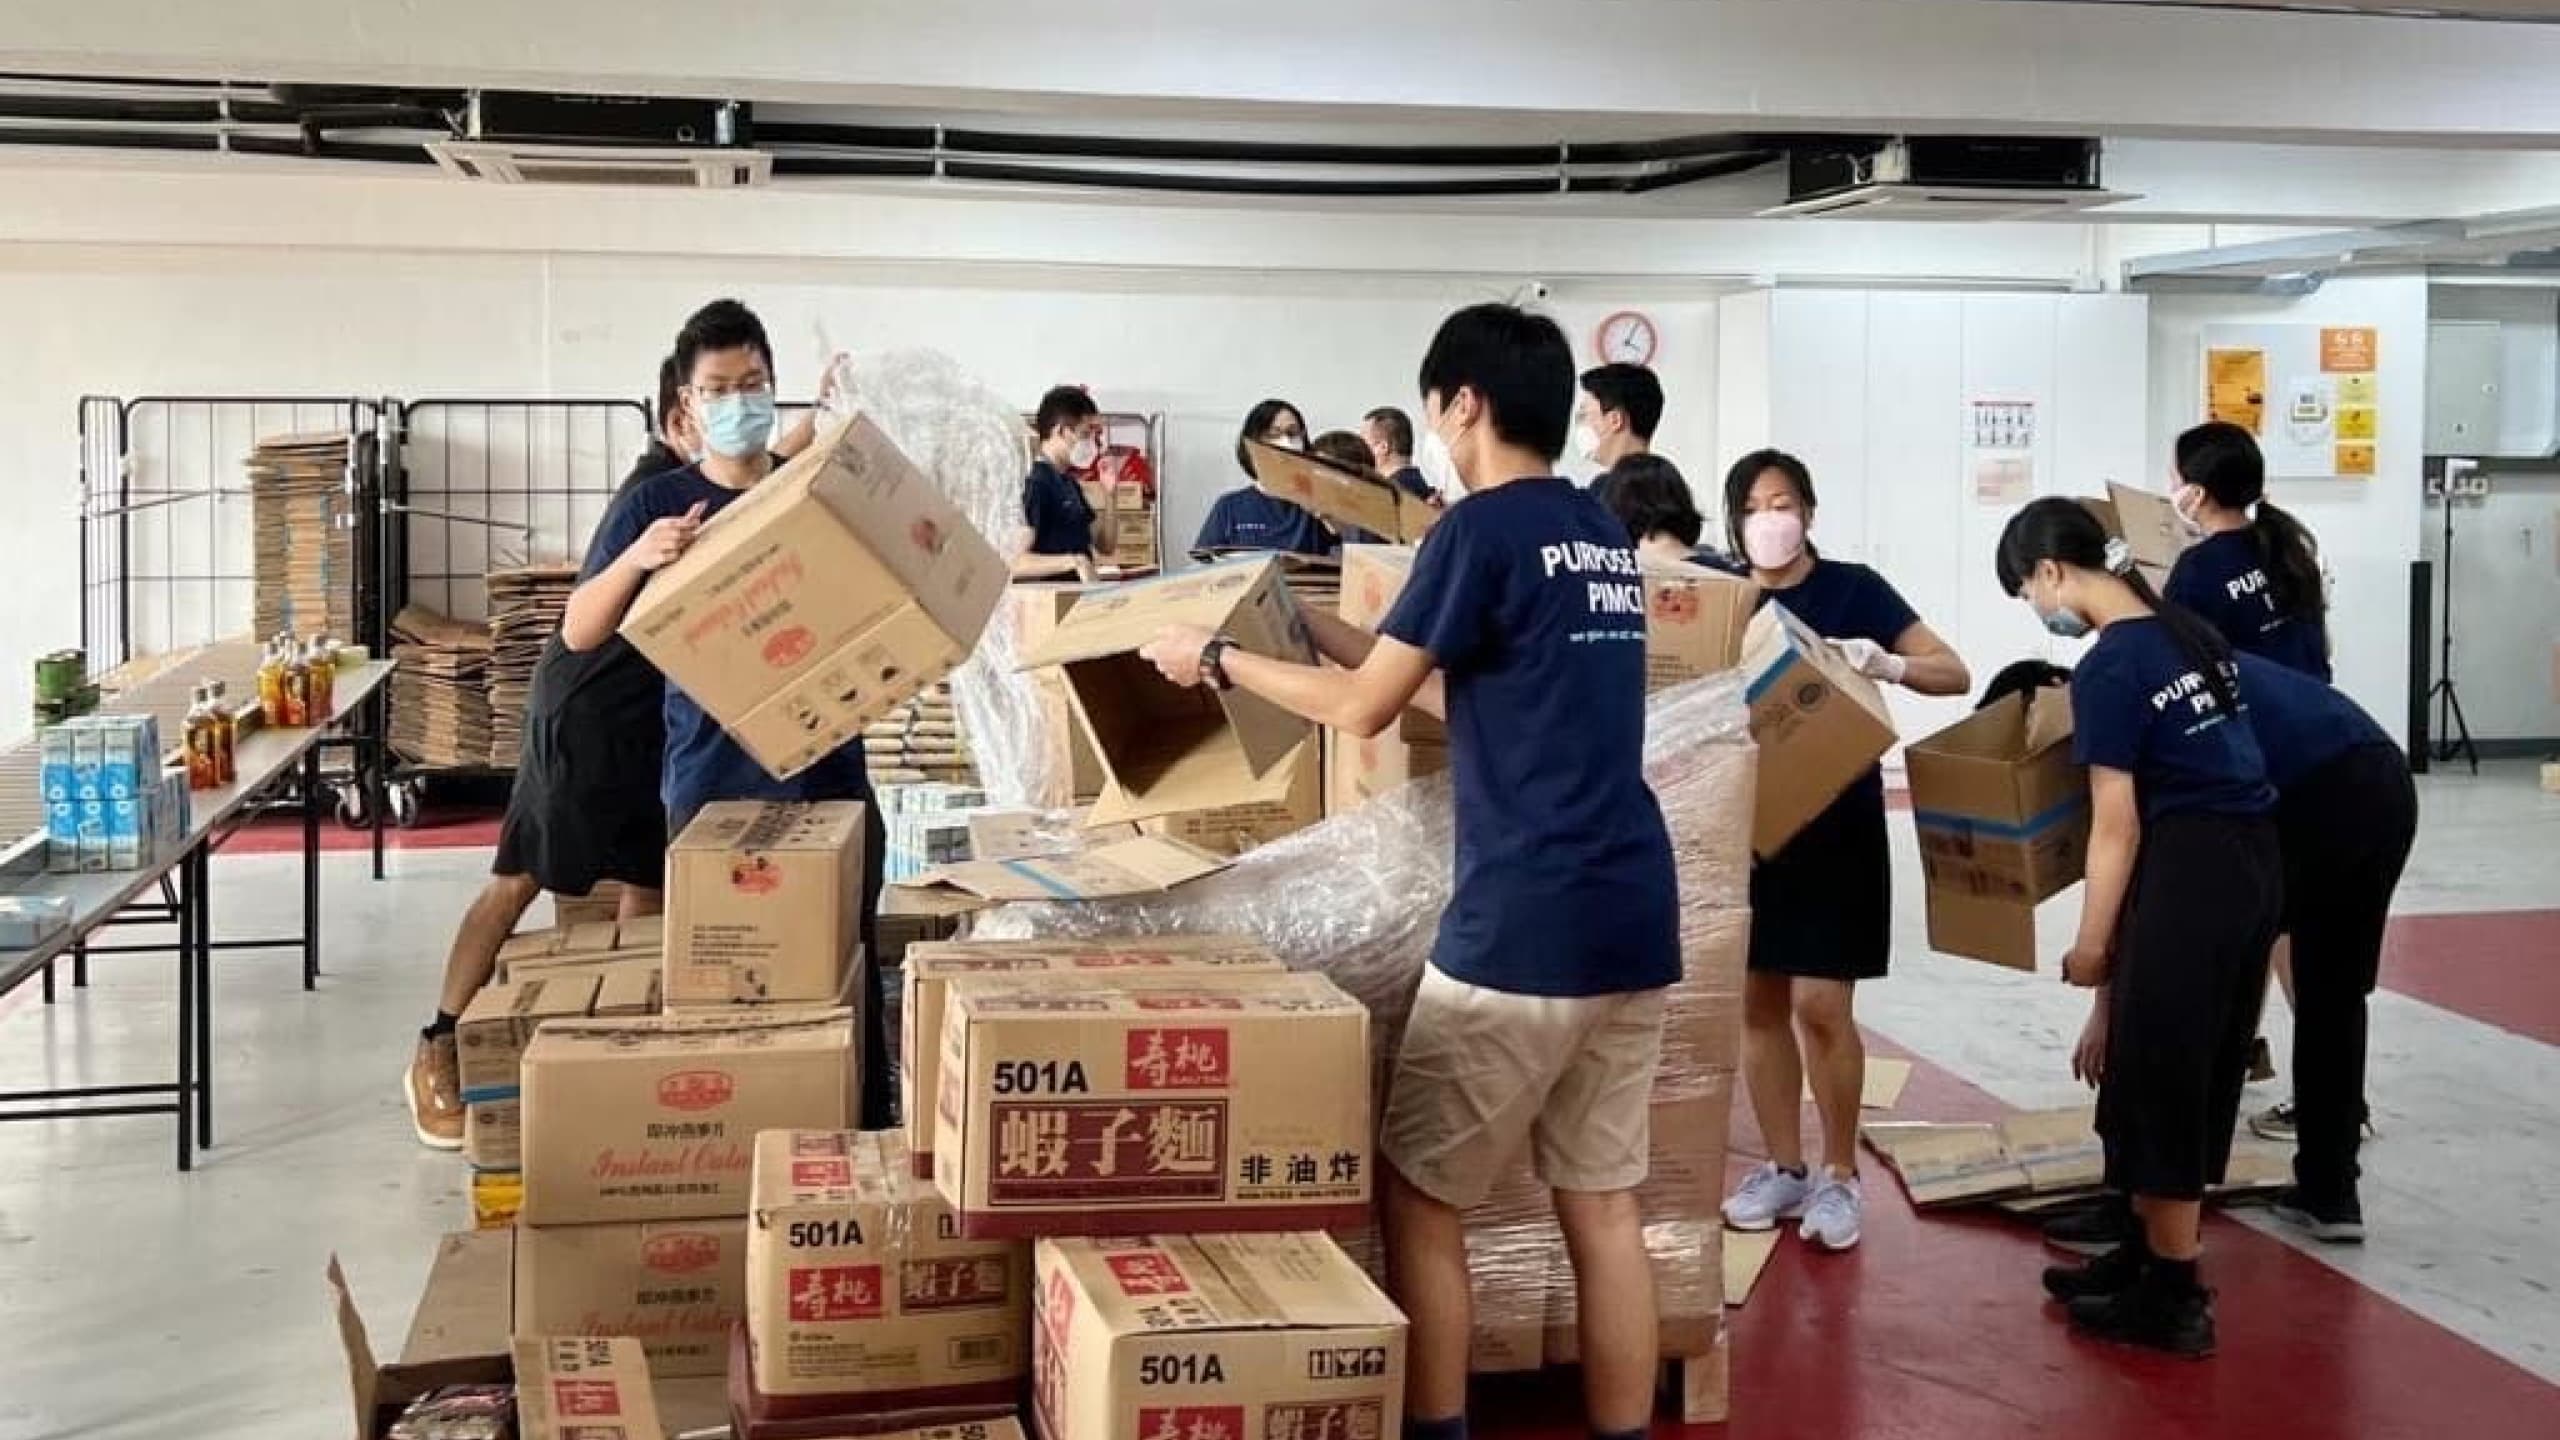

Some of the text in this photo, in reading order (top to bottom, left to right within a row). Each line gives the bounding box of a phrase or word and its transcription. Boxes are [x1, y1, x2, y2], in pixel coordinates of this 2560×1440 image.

[993, 1060, 1089, 1094] 501A
[1239, 1151, 1361, 1185] 非油炸
[789, 1218, 864, 1247] 501A
[1139, 1353, 1225, 1385] 501A
